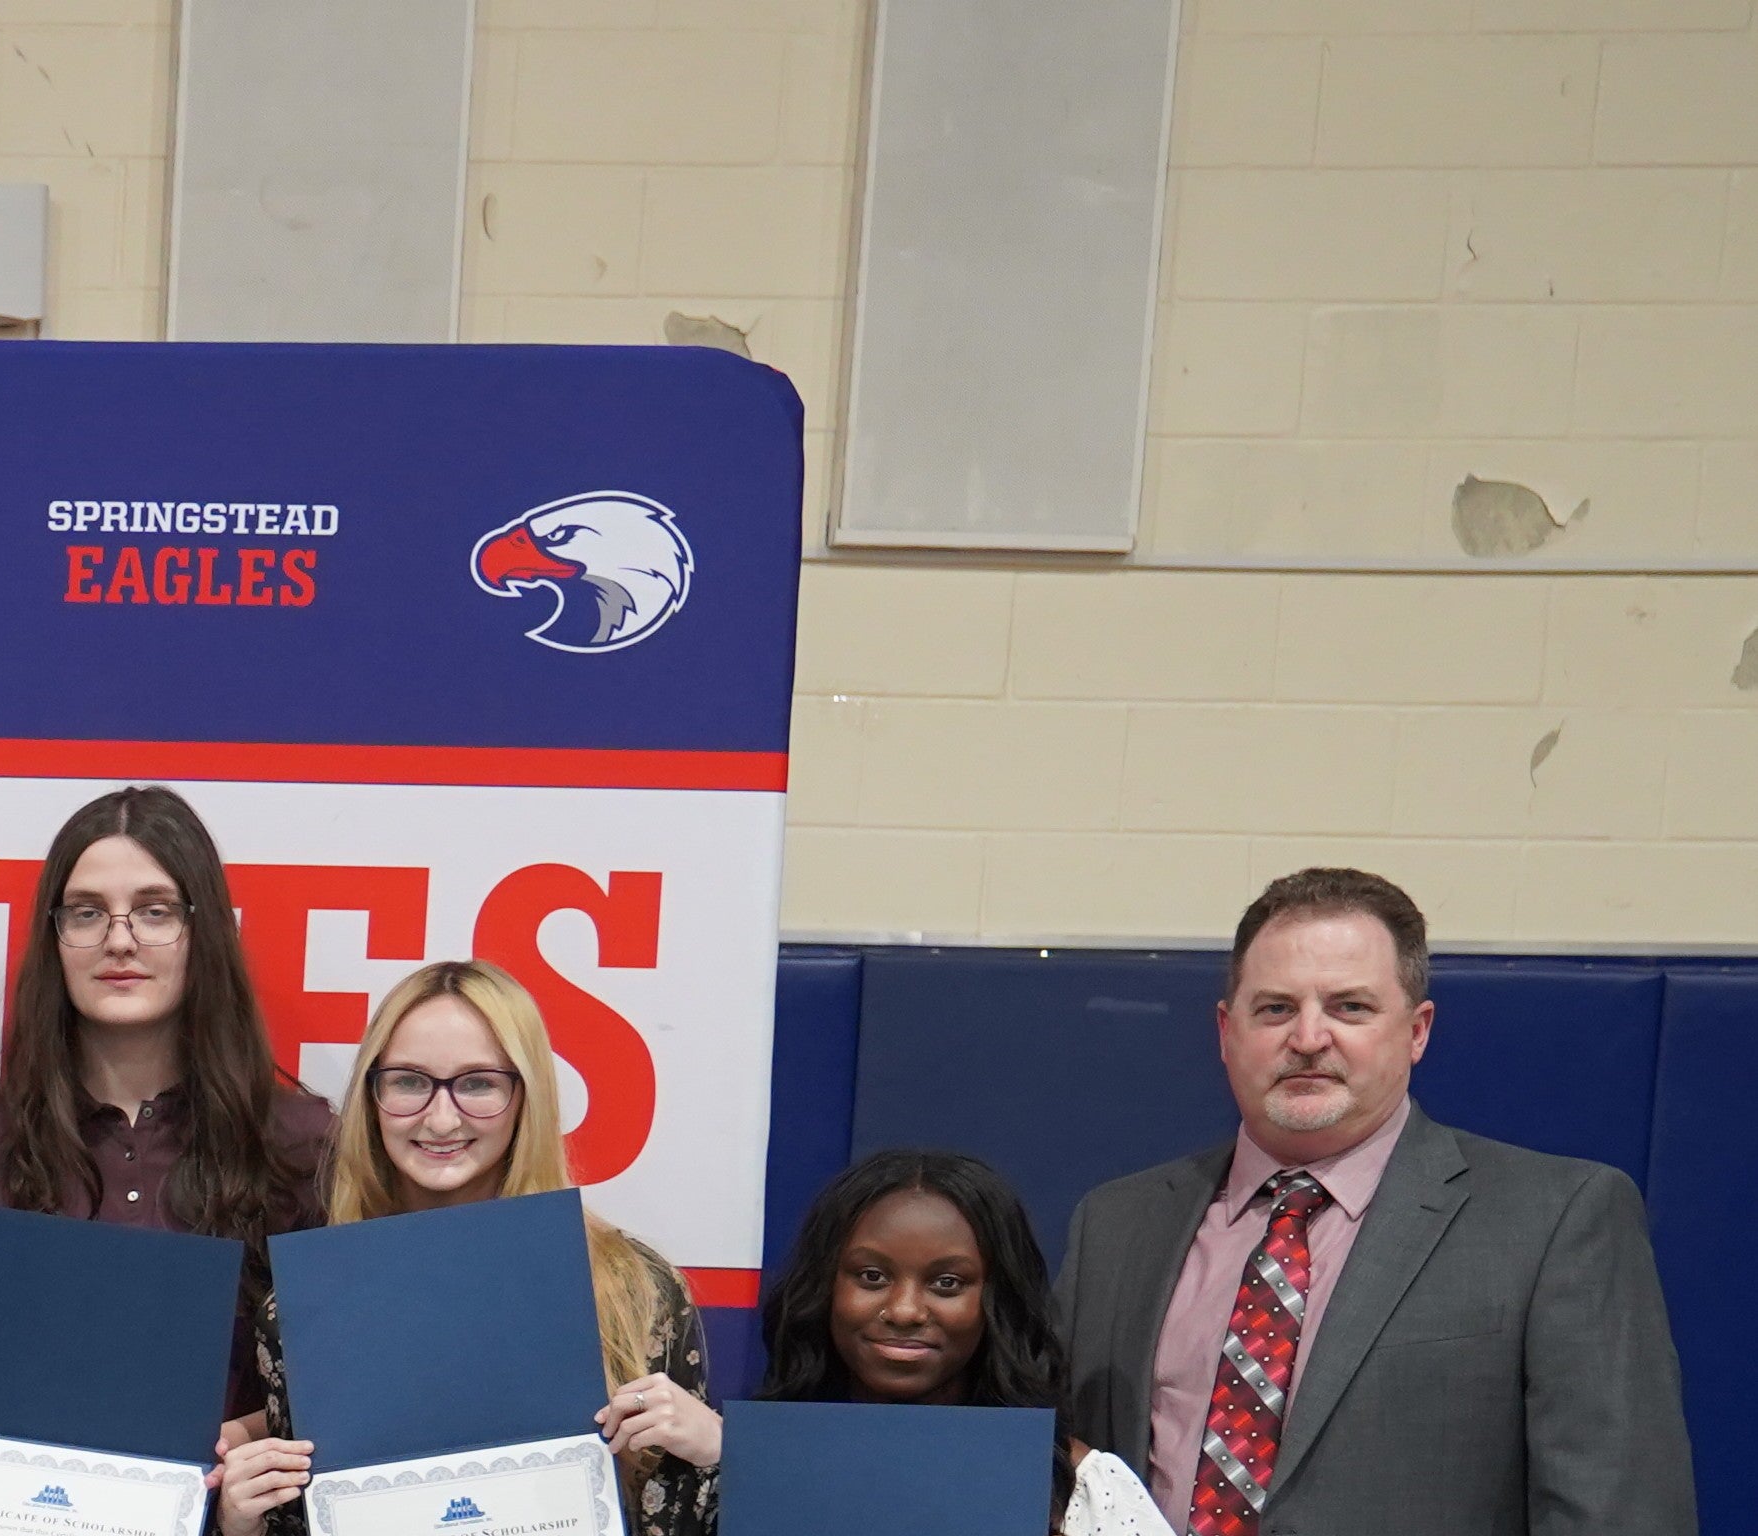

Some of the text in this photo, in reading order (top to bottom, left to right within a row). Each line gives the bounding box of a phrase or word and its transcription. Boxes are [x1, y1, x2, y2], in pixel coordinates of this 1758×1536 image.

[47, 500, 339, 536] SPRINGSTEAD
[64, 545, 317, 607] EAGLES
[42, 1516, 59, 1525] OF
